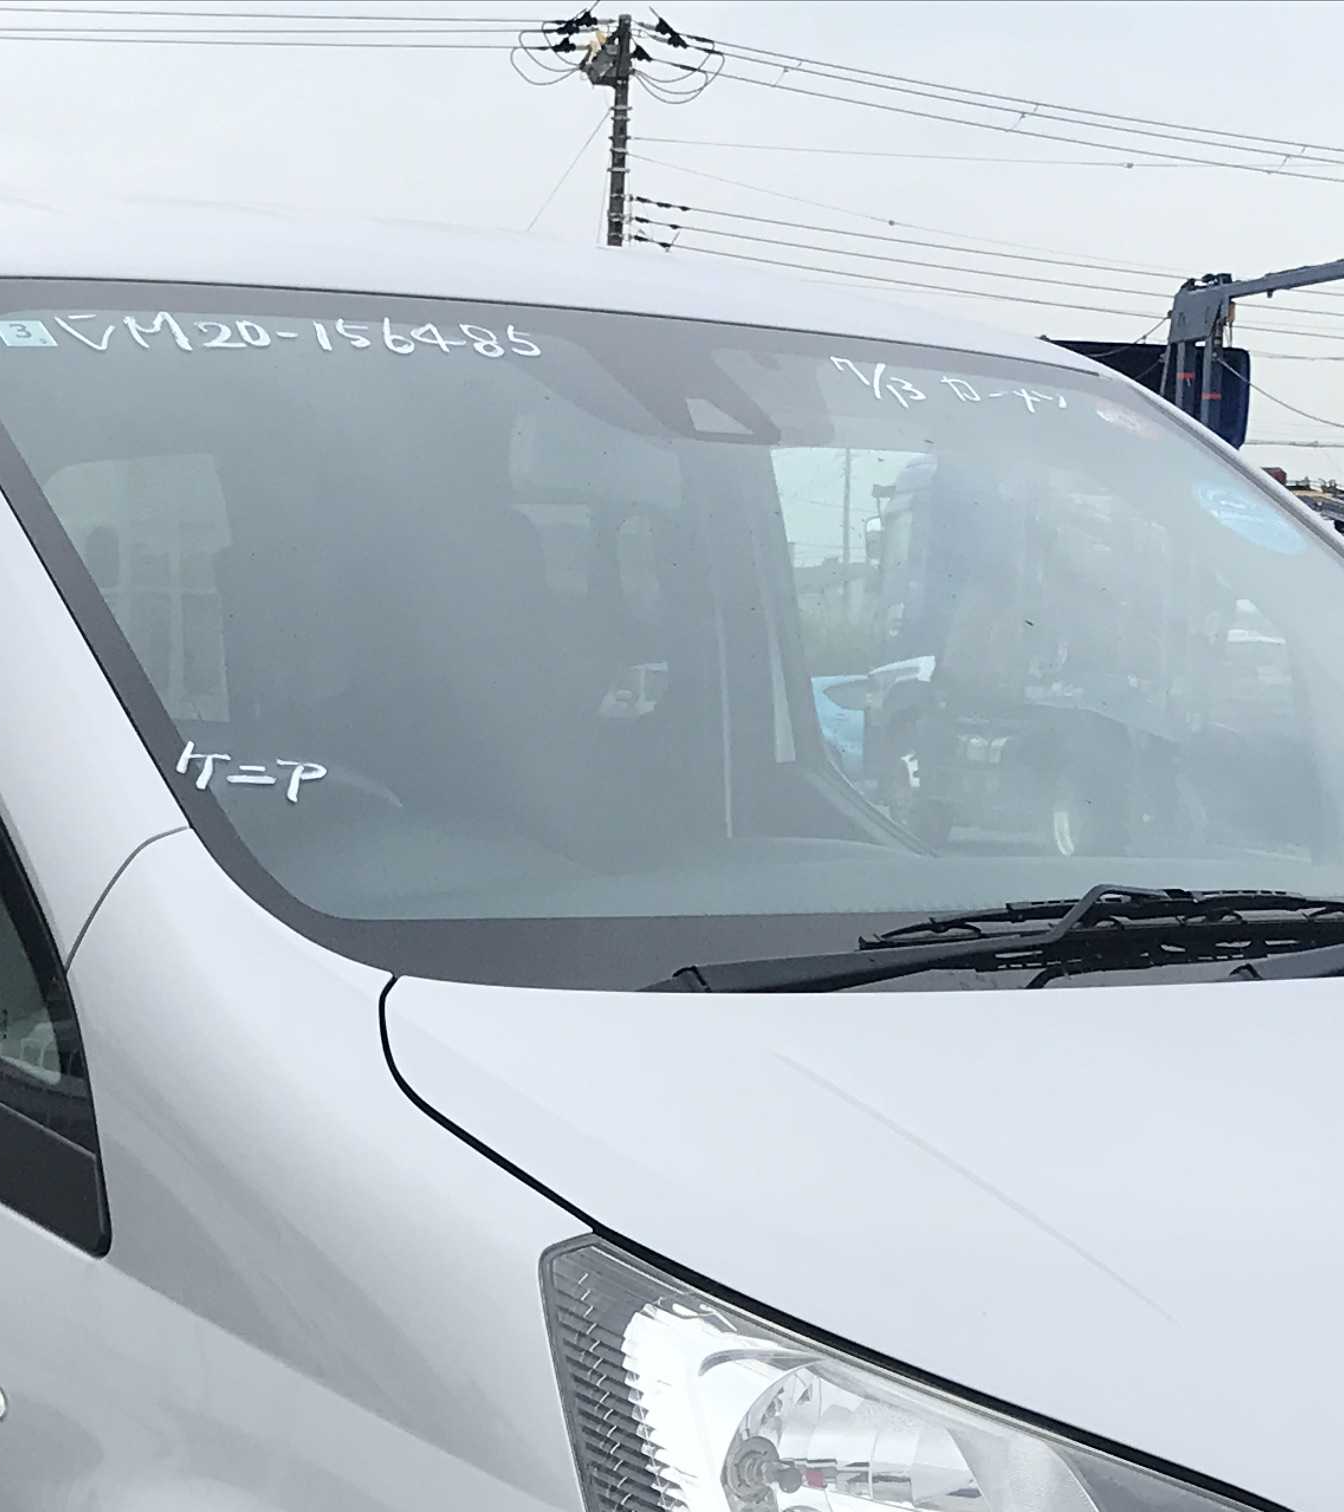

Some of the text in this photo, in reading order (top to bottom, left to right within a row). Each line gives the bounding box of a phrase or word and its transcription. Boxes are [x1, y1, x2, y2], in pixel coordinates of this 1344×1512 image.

[8, 322, 34, 340] 3
[55, 311, 543, 358] VM20-156485
[175, 740, 328, 803] ケニア
